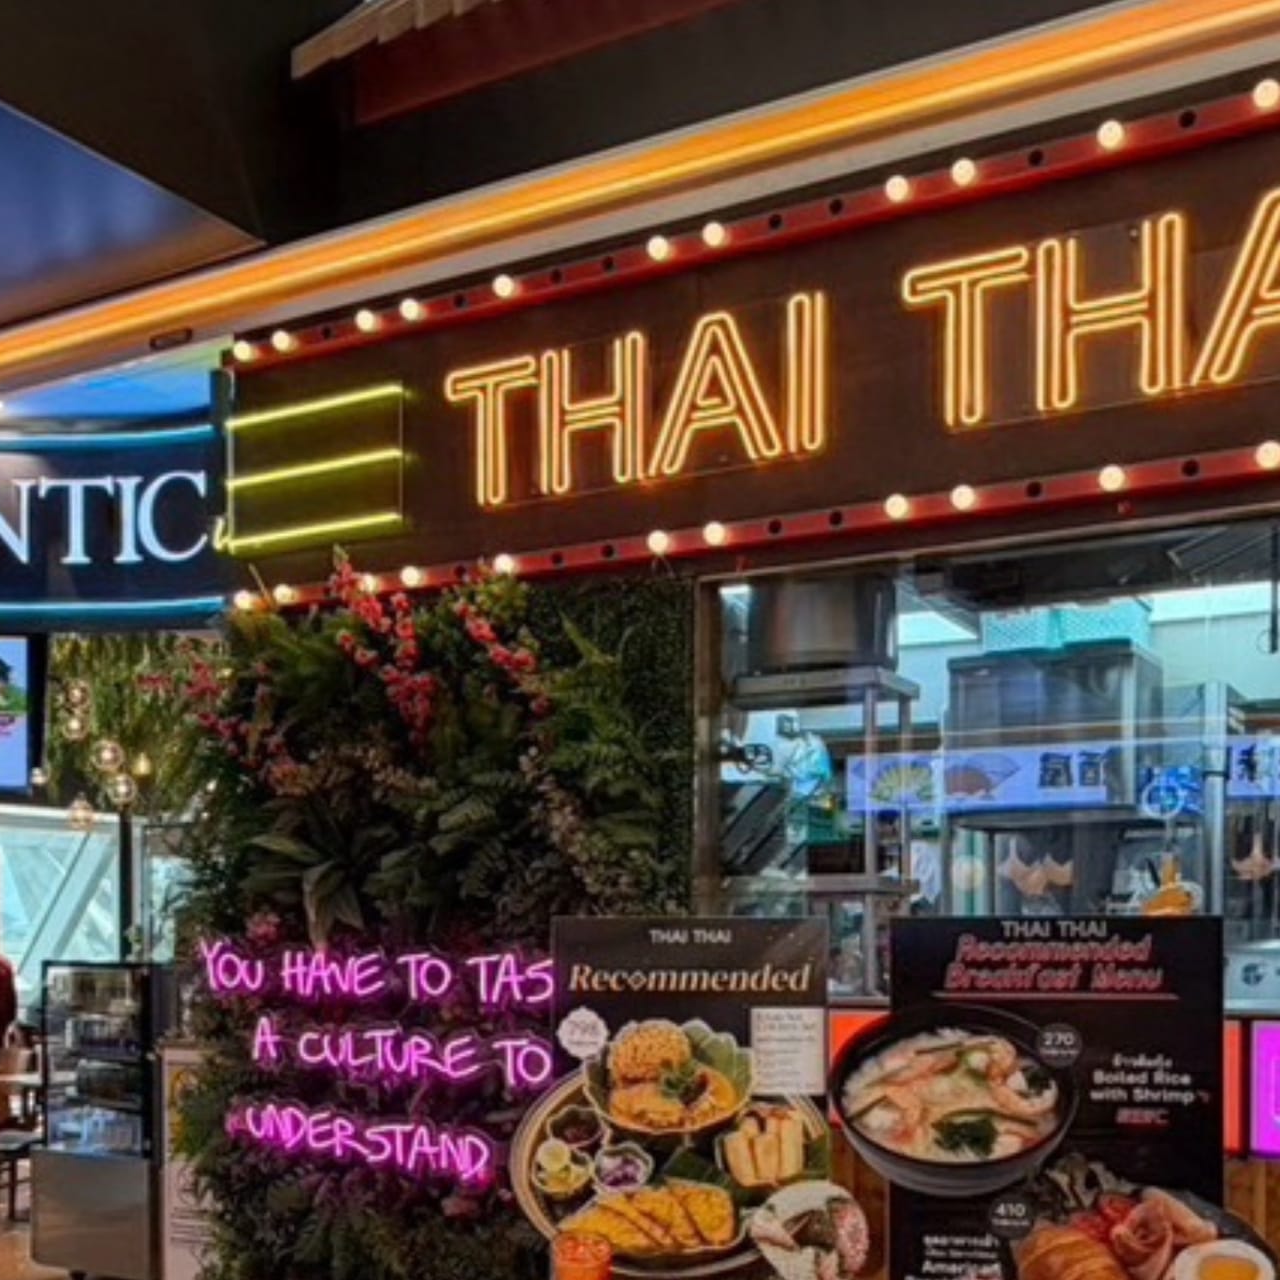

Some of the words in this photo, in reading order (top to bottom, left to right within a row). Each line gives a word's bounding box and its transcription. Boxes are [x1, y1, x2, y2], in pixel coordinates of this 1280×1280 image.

[445, 292, 826, 508] THAI
[649, 928, 689, 945] THAI
[693, 928, 733, 945] THAI
[1001, 920, 1051, 938] THAI
[1057, 920, 1108, 938] THAI
[956, 933, 1153, 962] Recommended
[199, 940, 264, 993] YOU
[281, 949, 385, 998] HAVE
[398, 954, 452, 997] TO
[568, 962, 813, 993] Recommended
[251, 1016, 278, 1062] A
[298, 1029, 480, 1081] CULTURE
[491, 1039, 552, 1085] TO
[1043, 1031, 1075, 1047] 270
[1153, 1070, 1191, 1086] Rice
[244, 1102, 490, 1177] UNDERSTAND
